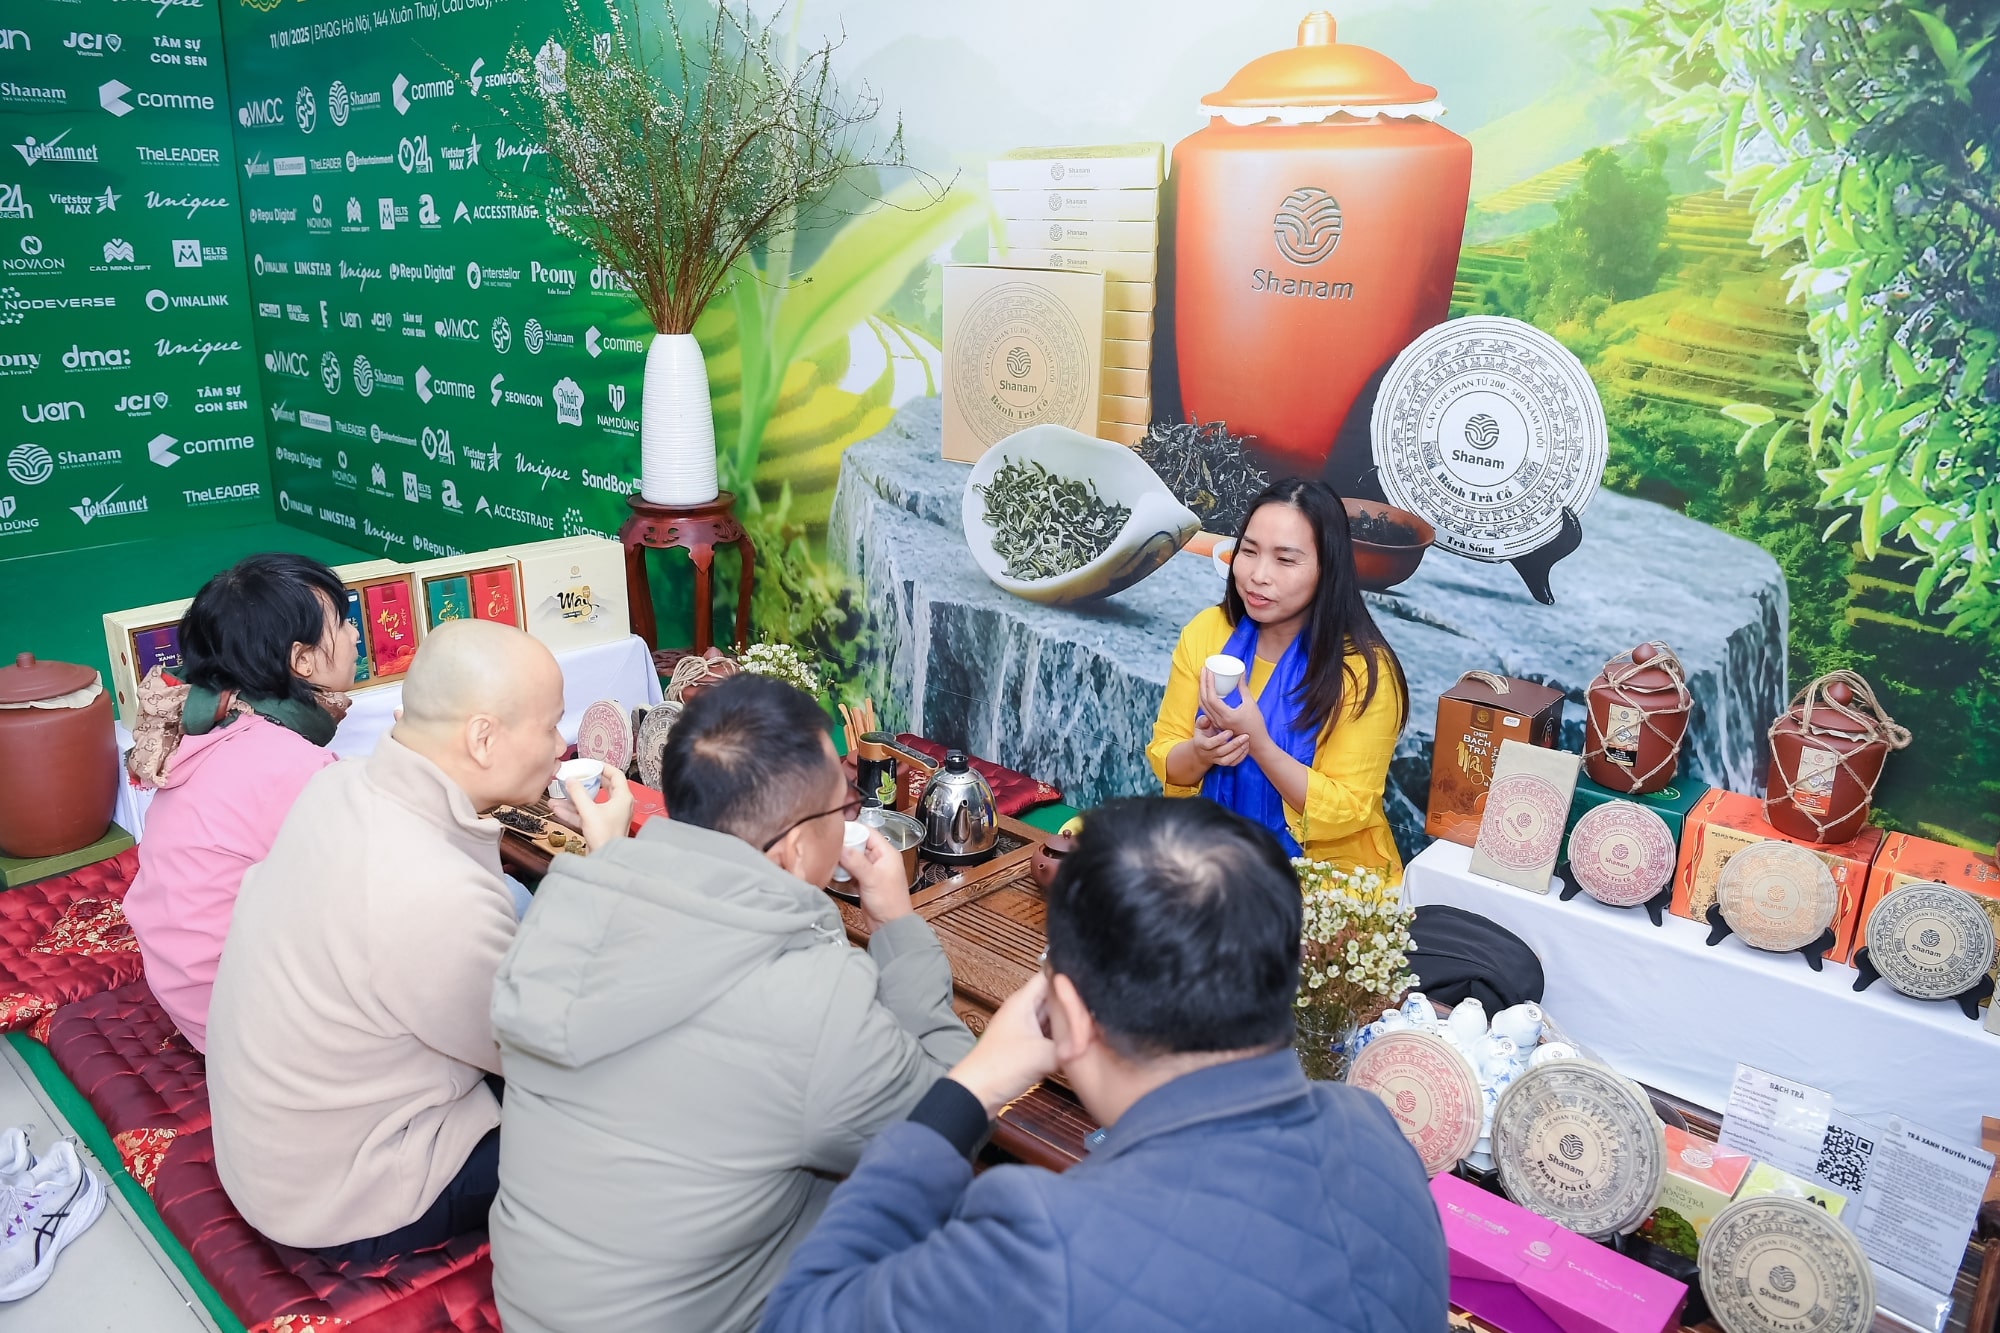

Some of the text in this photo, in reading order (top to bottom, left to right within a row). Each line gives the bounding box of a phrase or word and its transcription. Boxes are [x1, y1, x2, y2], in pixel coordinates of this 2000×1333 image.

[270, 27, 310, 49] 11/01/2025
[341, 18, 354, 35] Hà
[373, 11, 389, 28] 144
[389, 6, 414, 25] Xuân
[63, 32, 102, 50] JCI
[153, 35, 201, 52] TÂM SỰ
[150, 53, 208, 66] CON SEN
[1, 82, 67, 98] Shanam
[411, 79, 454, 100] comme
[137, 92, 215, 110] comme
[350, 92, 381, 106] Shanam
[247, 97, 284, 125] VMCC
[136, 146, 220, 163] TheLEADER
[310, 158, 342, 170] TheLEADER
[449, 159, 464, 170] MAX
[49, 193, 92, 204] Vietstar
[144, 190, 230, 220] Unique
[64, 204, 91, 215] MAX
[257, 209, 273, 222] Repu
[203, 246, 227, 255] IELTS
[339, 260, 381, 293] Unique
[400, 263, 455, 284] Repu Digital
[531, 261, 577, 290] Peony
[1251, 268, 1354, 301] Shanam
[5, 297, 116, 310] NODEVERSE
[170, 295, 229, 307] VINALINK
[371, 313, 385, 326] JCI
[444, 318, 479, 340] VMCC
[545, 329, 574, 344] Shanam
[155, 338, 242, 365] Unique
[603, 336, 643, 353] comme
[273, 350, 309, 377] VMCC
[374, 368, 404, 386] Shanam
[197, 385, 241, 398] TÂM SỰ
[434, 379, 475, 399] comme
[999, 379, 1037, 394] Shanam
[114, 395, 151, 411] JCI
[195, 400, 248, 413] CON SEN
[505, 391, 543, 408] SEONGON
[1434, 391, 1451, 411] CHÈ
[1449, 380, 1475, 396] SHAN
[1476, 376, 1489, 387] TỪ
[1489, 379, 1506, 391] 200
[1511, 388, 1526, 403] 500
[1525, 401, 1541, 425] NĂM
[1016, 406, 1036, 419] Trà
[183, 436, 254, 455] comme
[58, 449, 121, 465] Shanam
[283, 448, 300, 463] Repu
[1451, 449, 1506, 470] Shanam
[471, 459, 486, 472] MAX
[515, 452, 571, 492] Unique
[582, 469, 633, 495] SandBox
[1437, 471, 1513, 503] Bánh Trà Cổ
[182, 483, 260, 503] TheLEADER
[494, 503, 554, 531] ACCESSTRADE
[363, 518, 406, 552] Unique
[423, 537, 444, 557] Repu
[1447, 535, 1495, 555] Trà Sống
[1505, 817, 1523, 838] Shanam
[1605, 857, 1630, 869] Shanam
[1760, 901, 1789, 912] Shanam
[1911, 944, 1942, 958] Shanam
[1907, 1131, 1920, 1141] TRÀ
[1920, 1138, 1940, 1150] XANH
[1547, 1153, 1584, 1177] Shanam
[1559, 1182, 1576, 1192] Trà
[1759, 1287, 1800, 1309] Shanam
